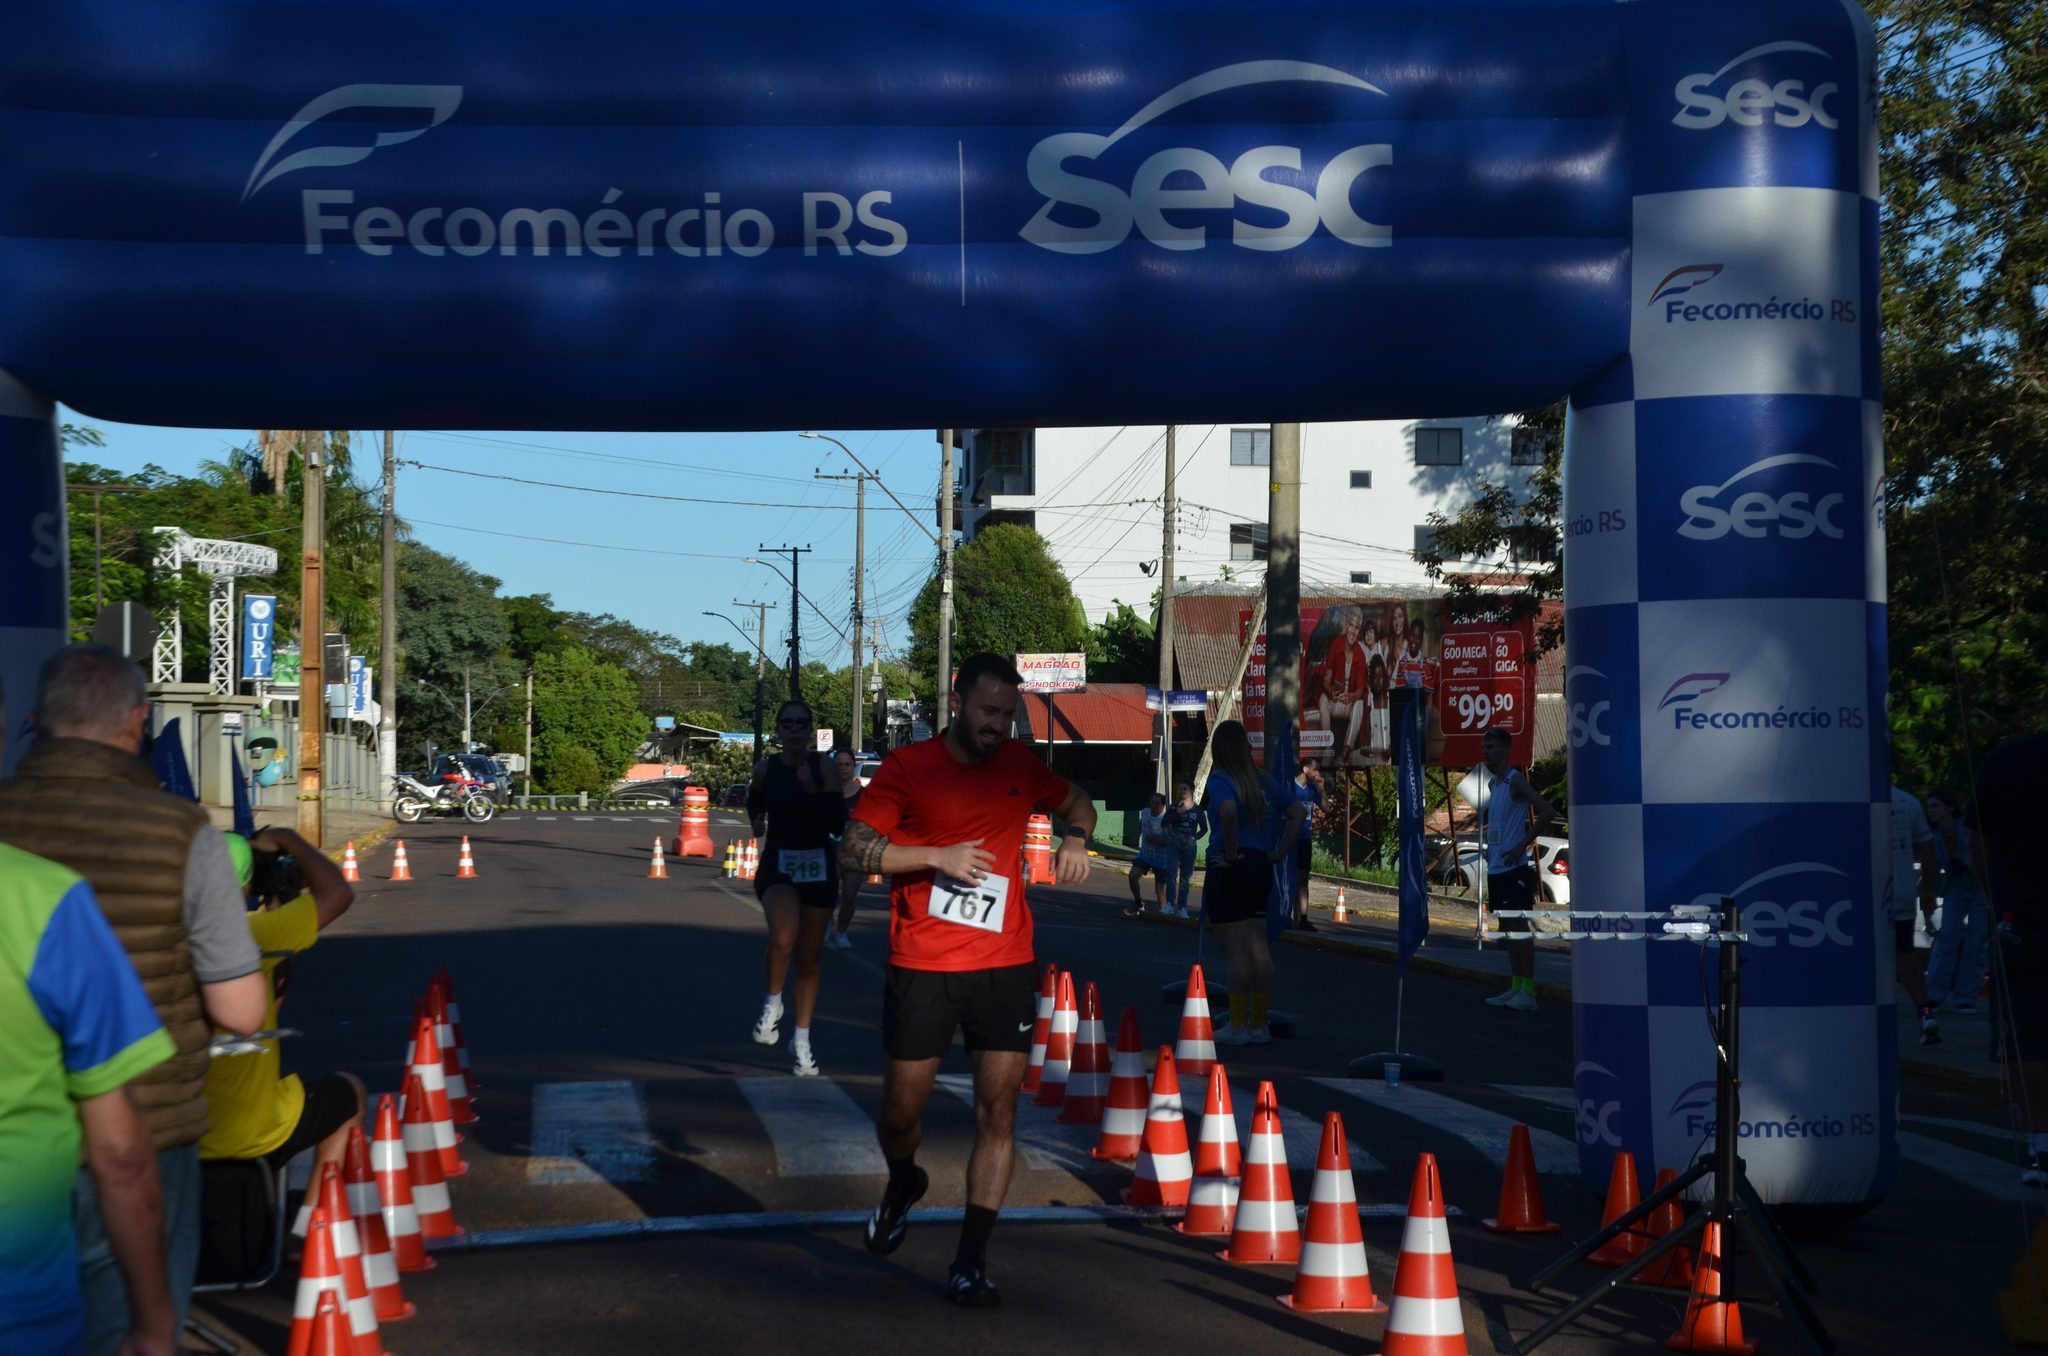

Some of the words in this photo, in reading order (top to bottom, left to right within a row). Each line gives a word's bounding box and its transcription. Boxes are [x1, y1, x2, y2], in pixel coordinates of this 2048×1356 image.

[302, 188, 775, 257] Fecomércio
[802, 190, 908, 257] RS
[1666, 296, 1824, 323] Fecomércio
[1830, 299, 1856, 323] RS
[1599, 509, 1627, 533] RS
[251, 622, 270, 676] URI
[1444, 647, 1461, 660] 600
[1461, 646, 1488, 659] MEGA
[1495, 645, 1509, 658] 60
[1495, 660, 1518, 672] GIGA
[1448, 696, 1457, 708] R$
[1674, 705, 1831, 730] Fecomércio
[1838, 706, 1864, 729] RS
[942, 884, 997, 923] 767
[1687, 1115, 1844, 1138] Feomércio
[1851, 1113, 1875, 1136] RS
